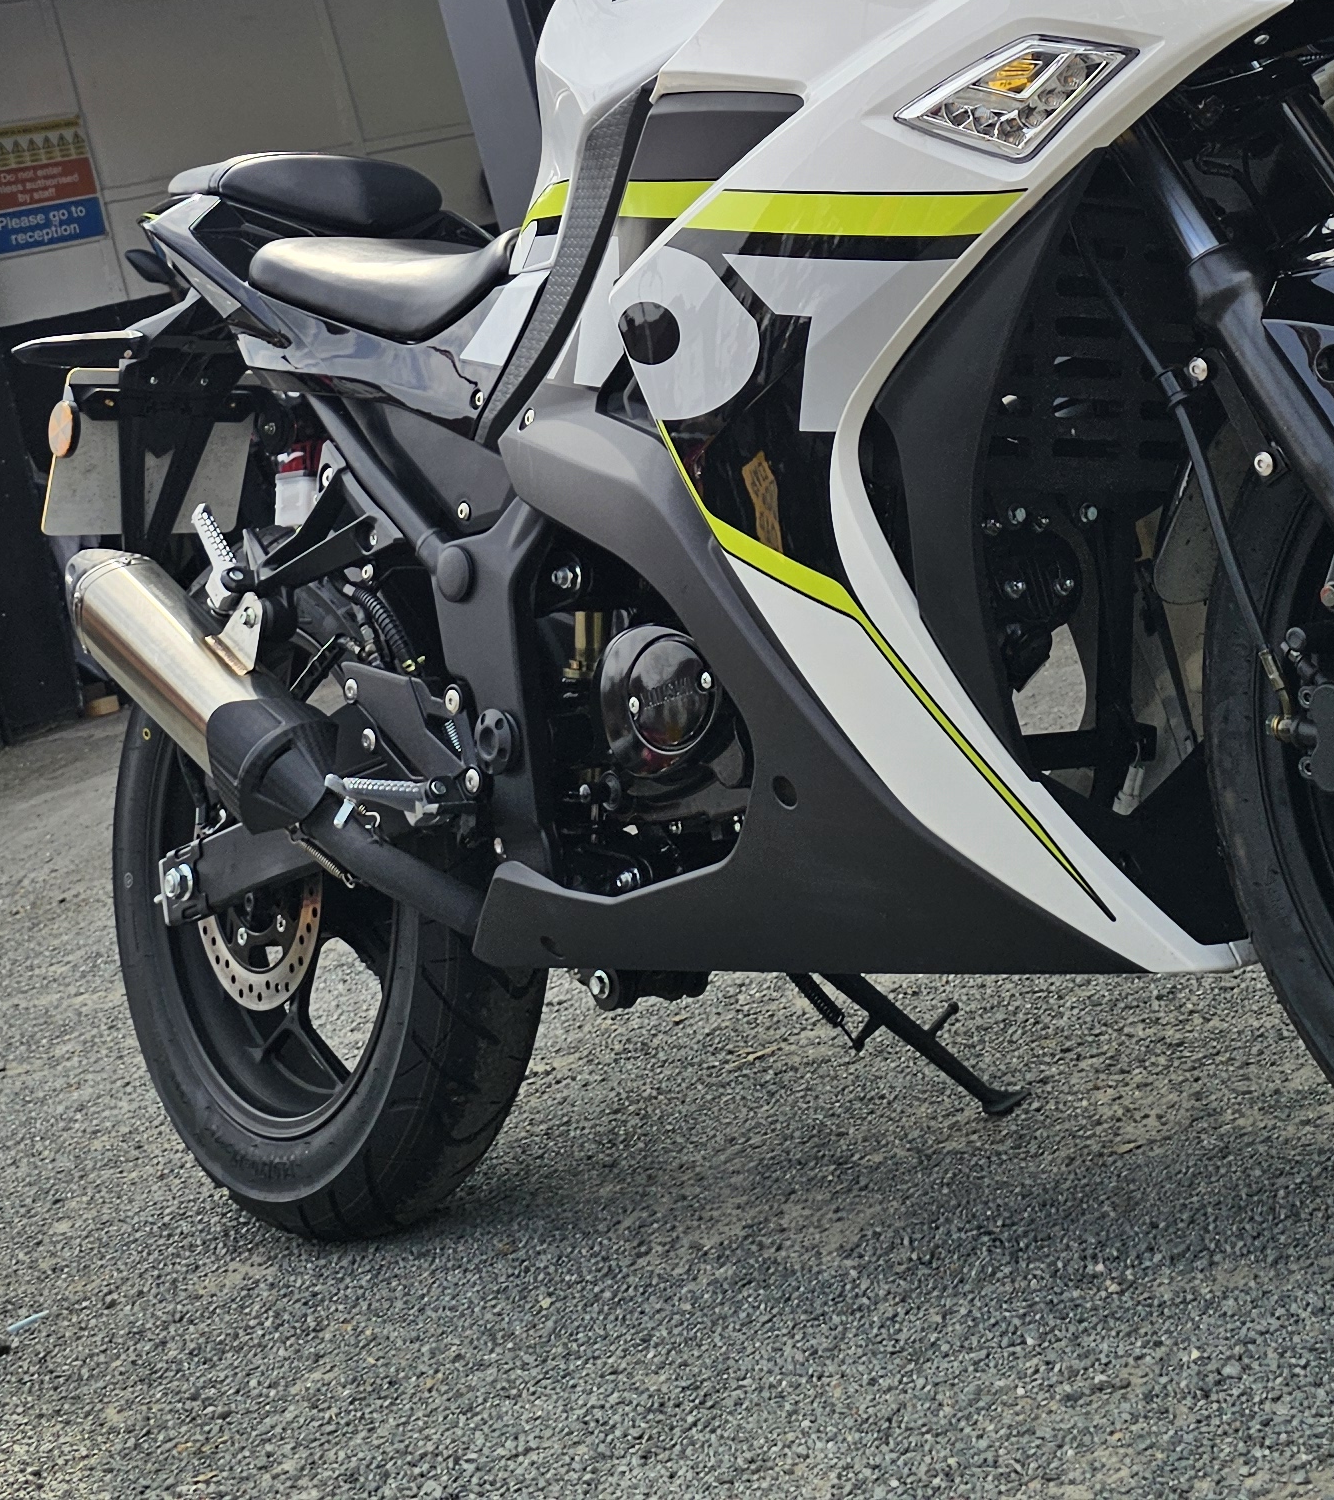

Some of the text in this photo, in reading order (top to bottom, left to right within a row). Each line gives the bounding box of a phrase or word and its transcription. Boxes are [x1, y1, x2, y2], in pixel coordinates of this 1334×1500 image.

[0, 165, 62, 183] Do not enter
[17, 187, 56, 204] by staff
[49, 210, 68, 225] go
[71, 205, 85, 217] to
[10, 223, 80, 245] reception
